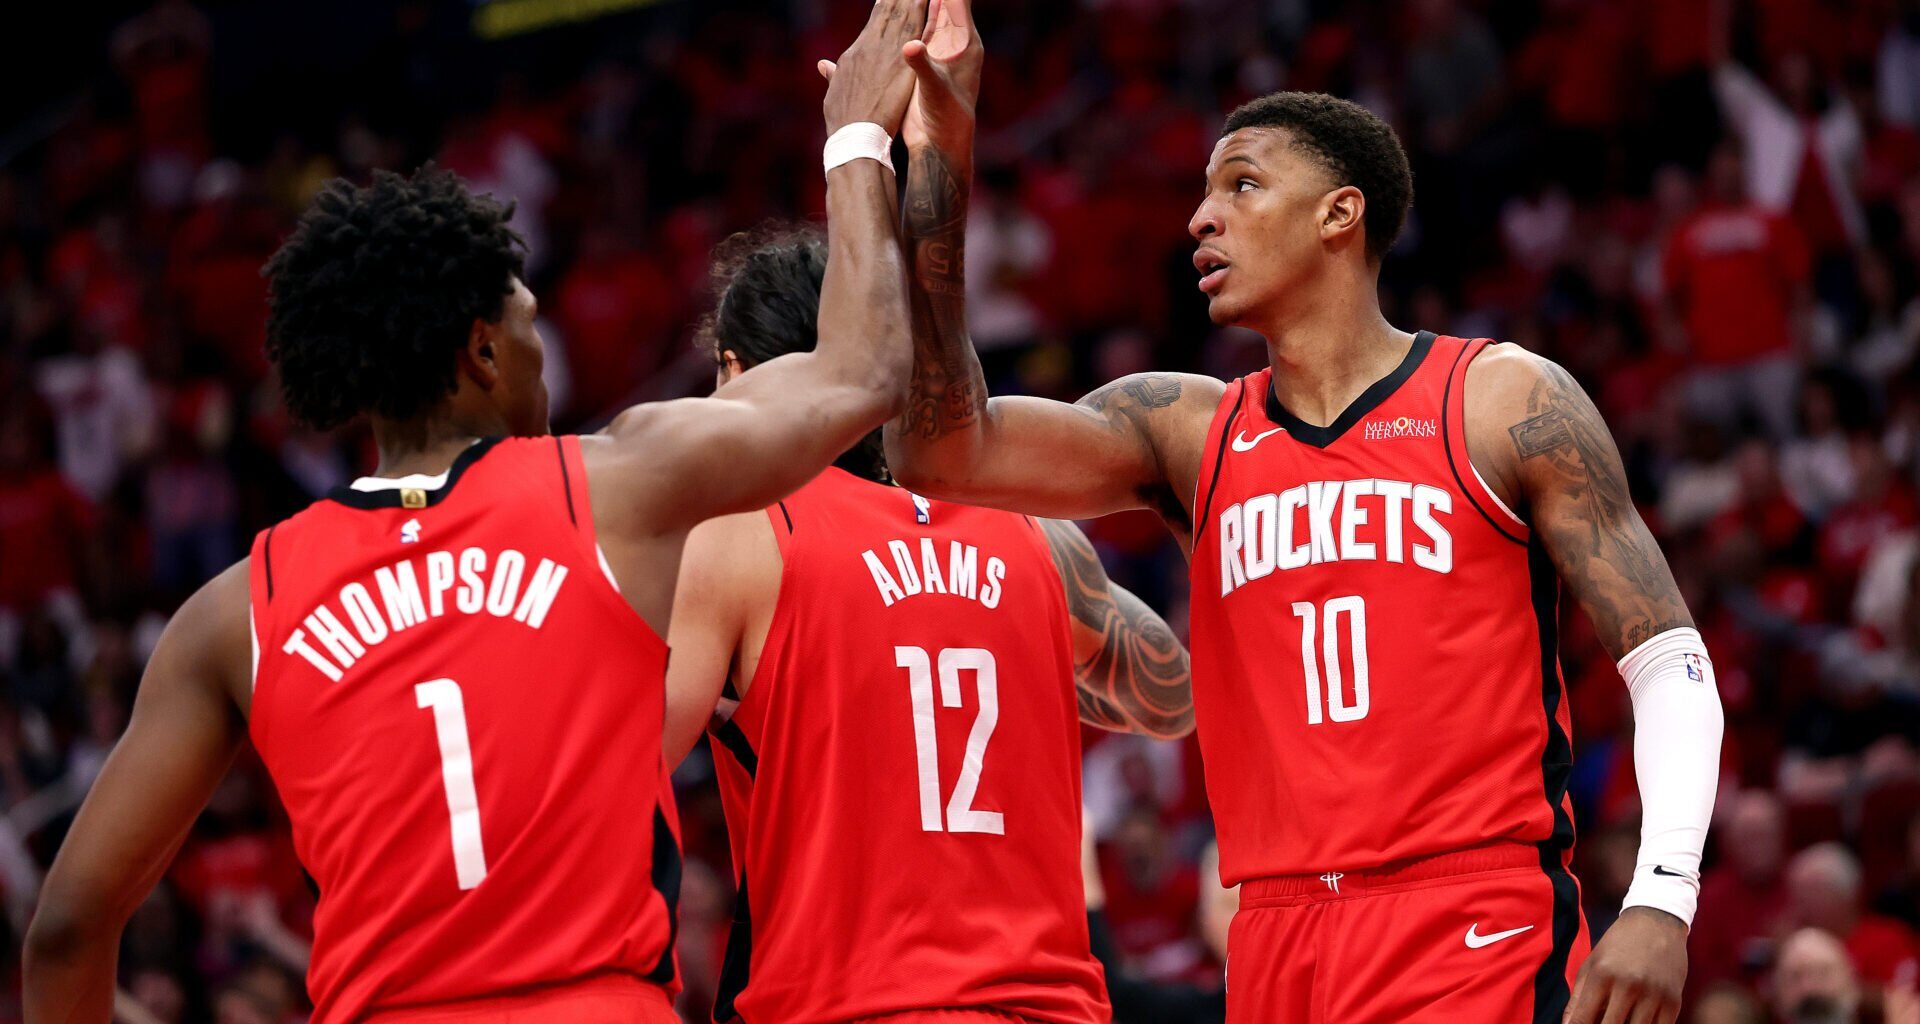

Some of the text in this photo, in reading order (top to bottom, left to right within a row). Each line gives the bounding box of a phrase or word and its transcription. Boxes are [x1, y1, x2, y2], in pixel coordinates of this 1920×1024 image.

[1365, 417, 1437, 431] MEMORIAL
[1365, 427, 1436, 440] HERMANN
[861, 537, 1006, 609] ADAMS
[1219, 477, 1453, 606] ROCKETS
[282, 546, 569, 683] THOMPSON
[1291, 595, 1370, 725] 10
[414, 677, 487, 890] 1
[894, 645, 1005, 836] 12
